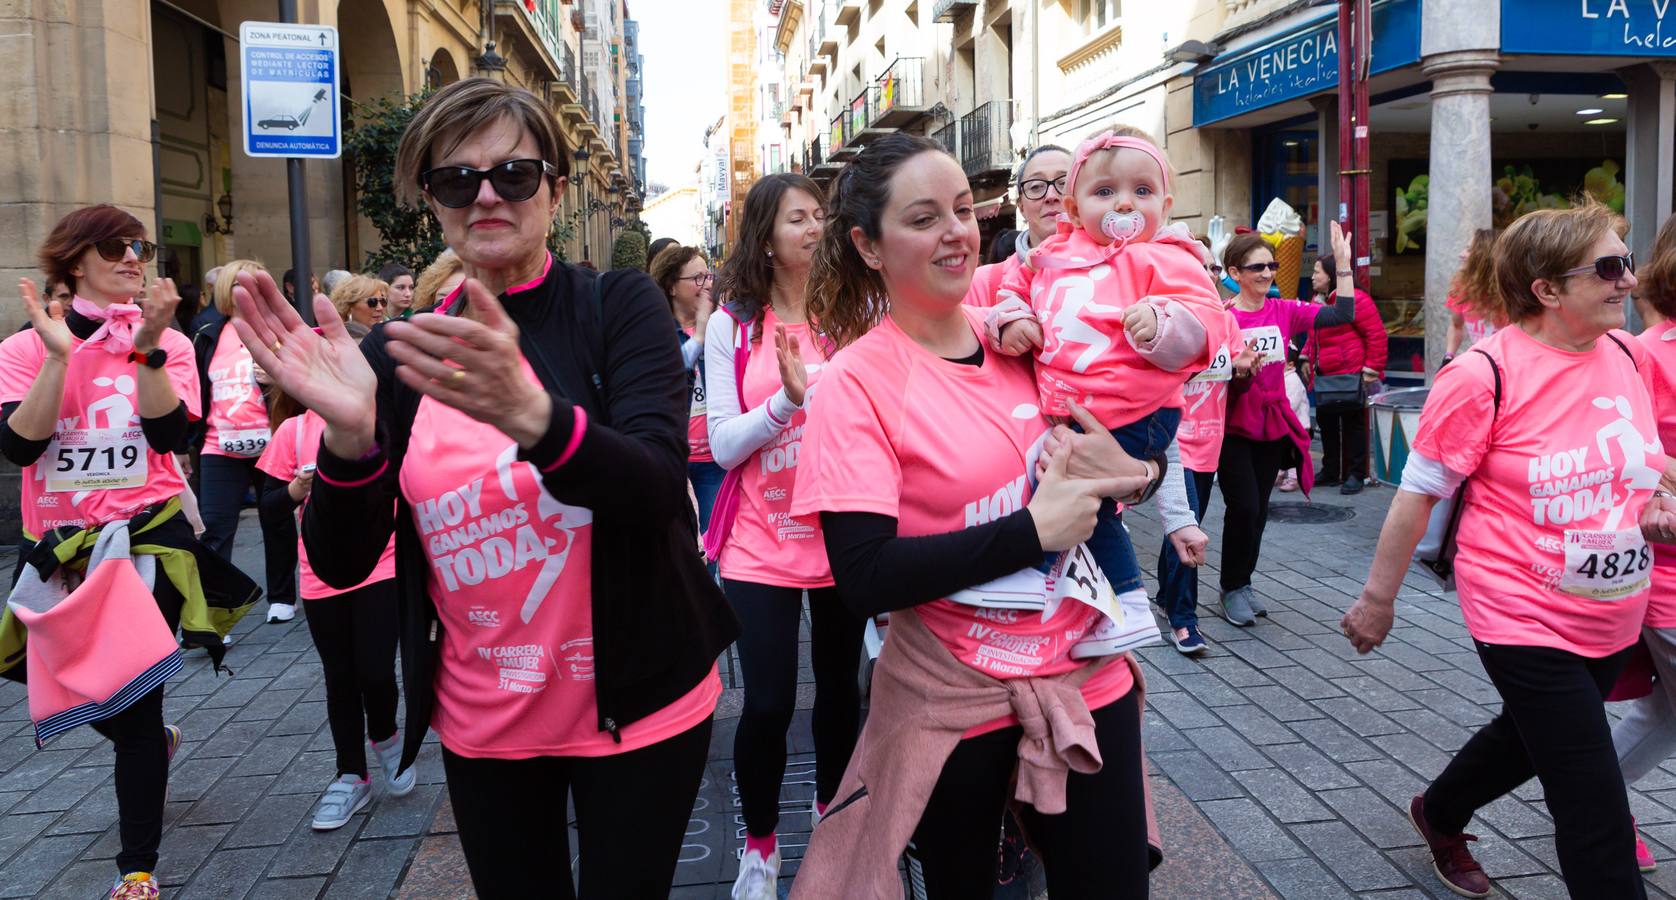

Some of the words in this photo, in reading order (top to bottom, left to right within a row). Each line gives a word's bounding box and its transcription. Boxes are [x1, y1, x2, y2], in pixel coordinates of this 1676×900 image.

[1582, 0, 1630, 18] LA
[272, 33, 312, 41] PEATONAL
[251, 60, 292, 68] MEDIANTE
[1218, 68, 1239, 94] LA
[1247, 30, 1337, 82] VENECIA
[1289, 61, 1338, 89] italia
[256, 141, 289, 149] DENUNCIA
[122, 430, 143, 438] AECC
[224, 438, 267, 453] 8339
[57, 445, 138, 472] 5719
[1528, 446, 1589, 482] HOY
[1529, 466, 1615, 497] GANAMOS
[37, 496, 58, 505] AECC
[763, 488, 787, 498] AECC
[416, 478, 484, 535] HOY
[965, 474, 1027, 529] HOY
[767, 512, 777, 524] IV
[429, 502, 529, 556] GANAMOS
[1576, 544, 1650, 580] 4828
[1066, 545, 1098, 601] 57
[468, 611, 499, 622] AECC
[975, 608, 1018, 622] AECC
[967, 623, 991, 640] IV
[477, 647, 491, 660] IV
[493, 645, 544, 658] CARRERA
[502, 657, 539, 670] MUJER
[972, 653, 988, 668] 31
[990, 660, 1024, 675] Marzo
[498, 678, 509, 690] 31
[509, 681, 532, 693] Marzo
